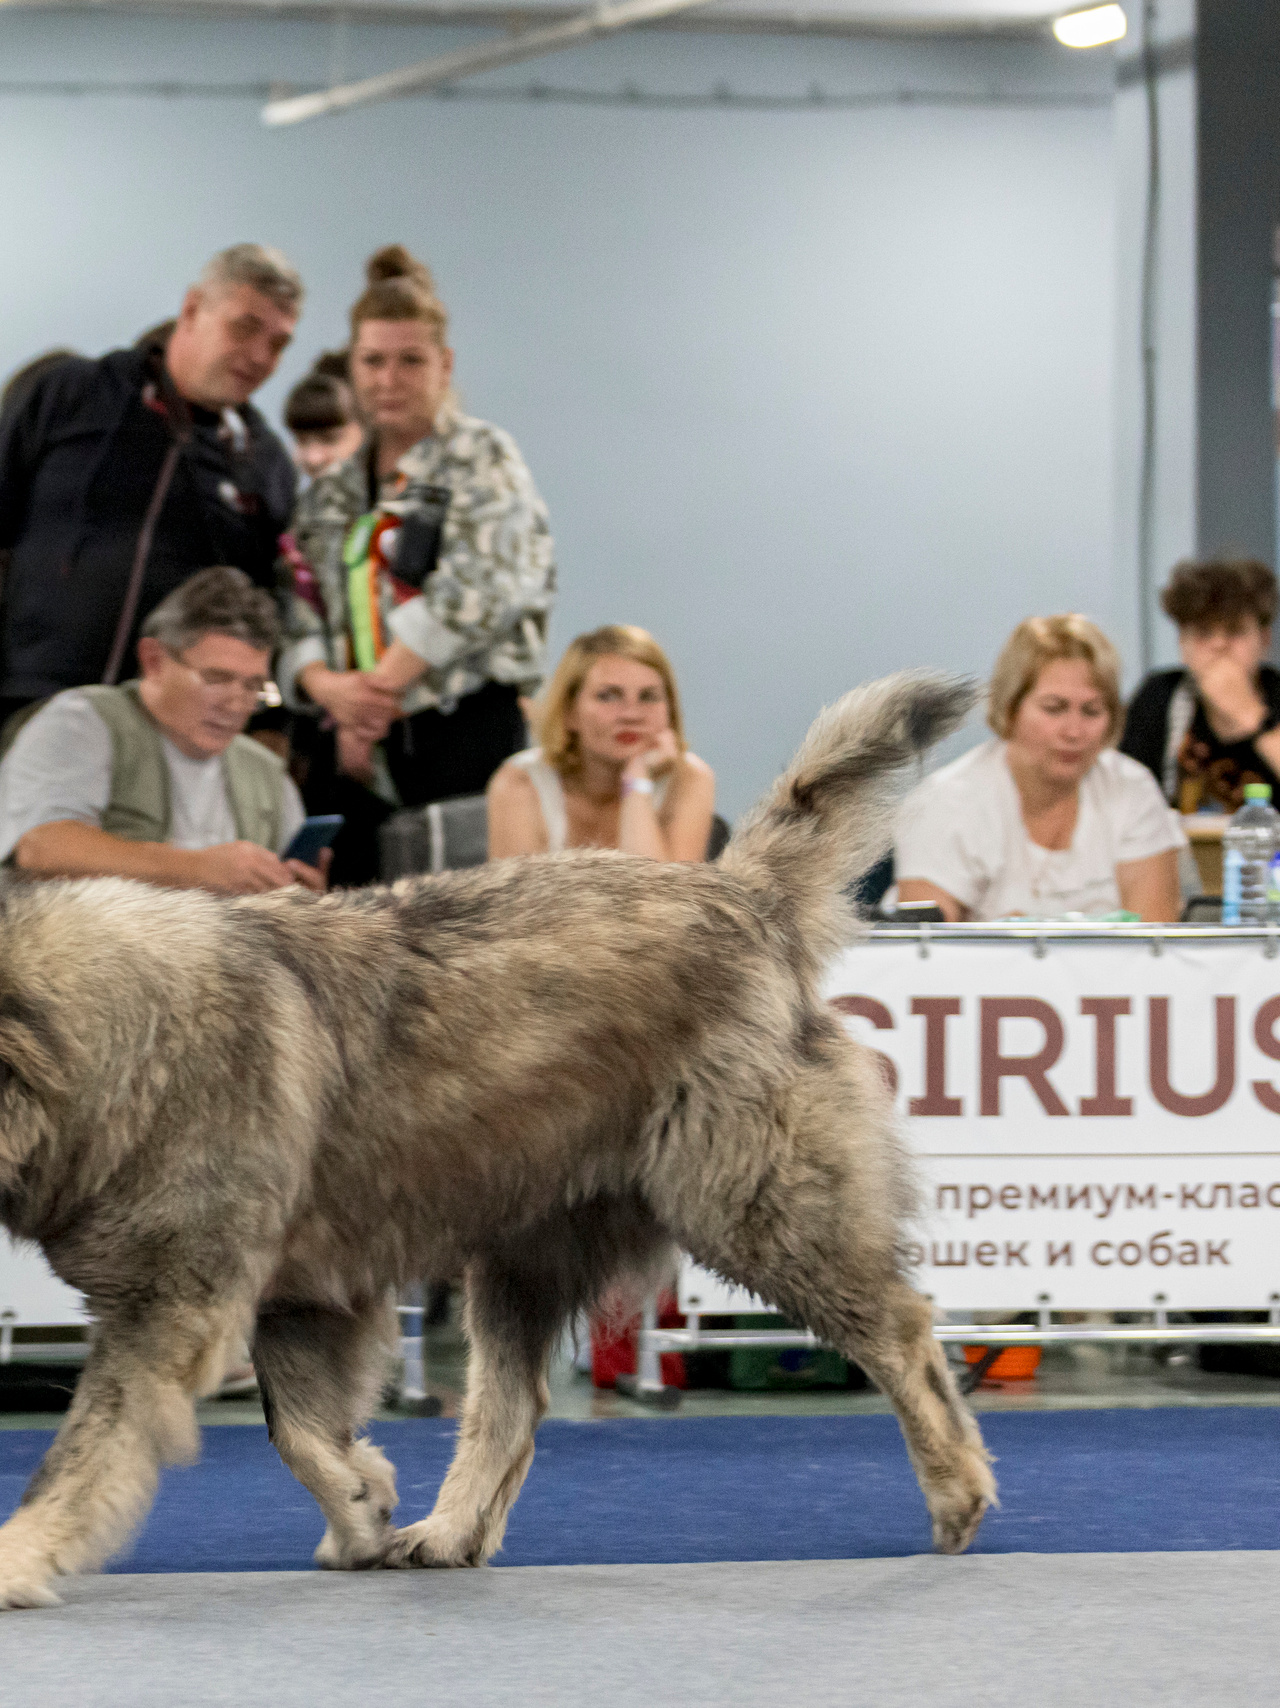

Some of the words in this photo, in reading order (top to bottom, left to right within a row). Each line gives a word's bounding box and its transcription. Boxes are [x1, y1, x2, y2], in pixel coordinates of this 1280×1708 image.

[905, 1241, 1030, 1266] ошек
[1046, 1241, 1072, 1266] и
[1091, 1230, 1231, 1266] собак
